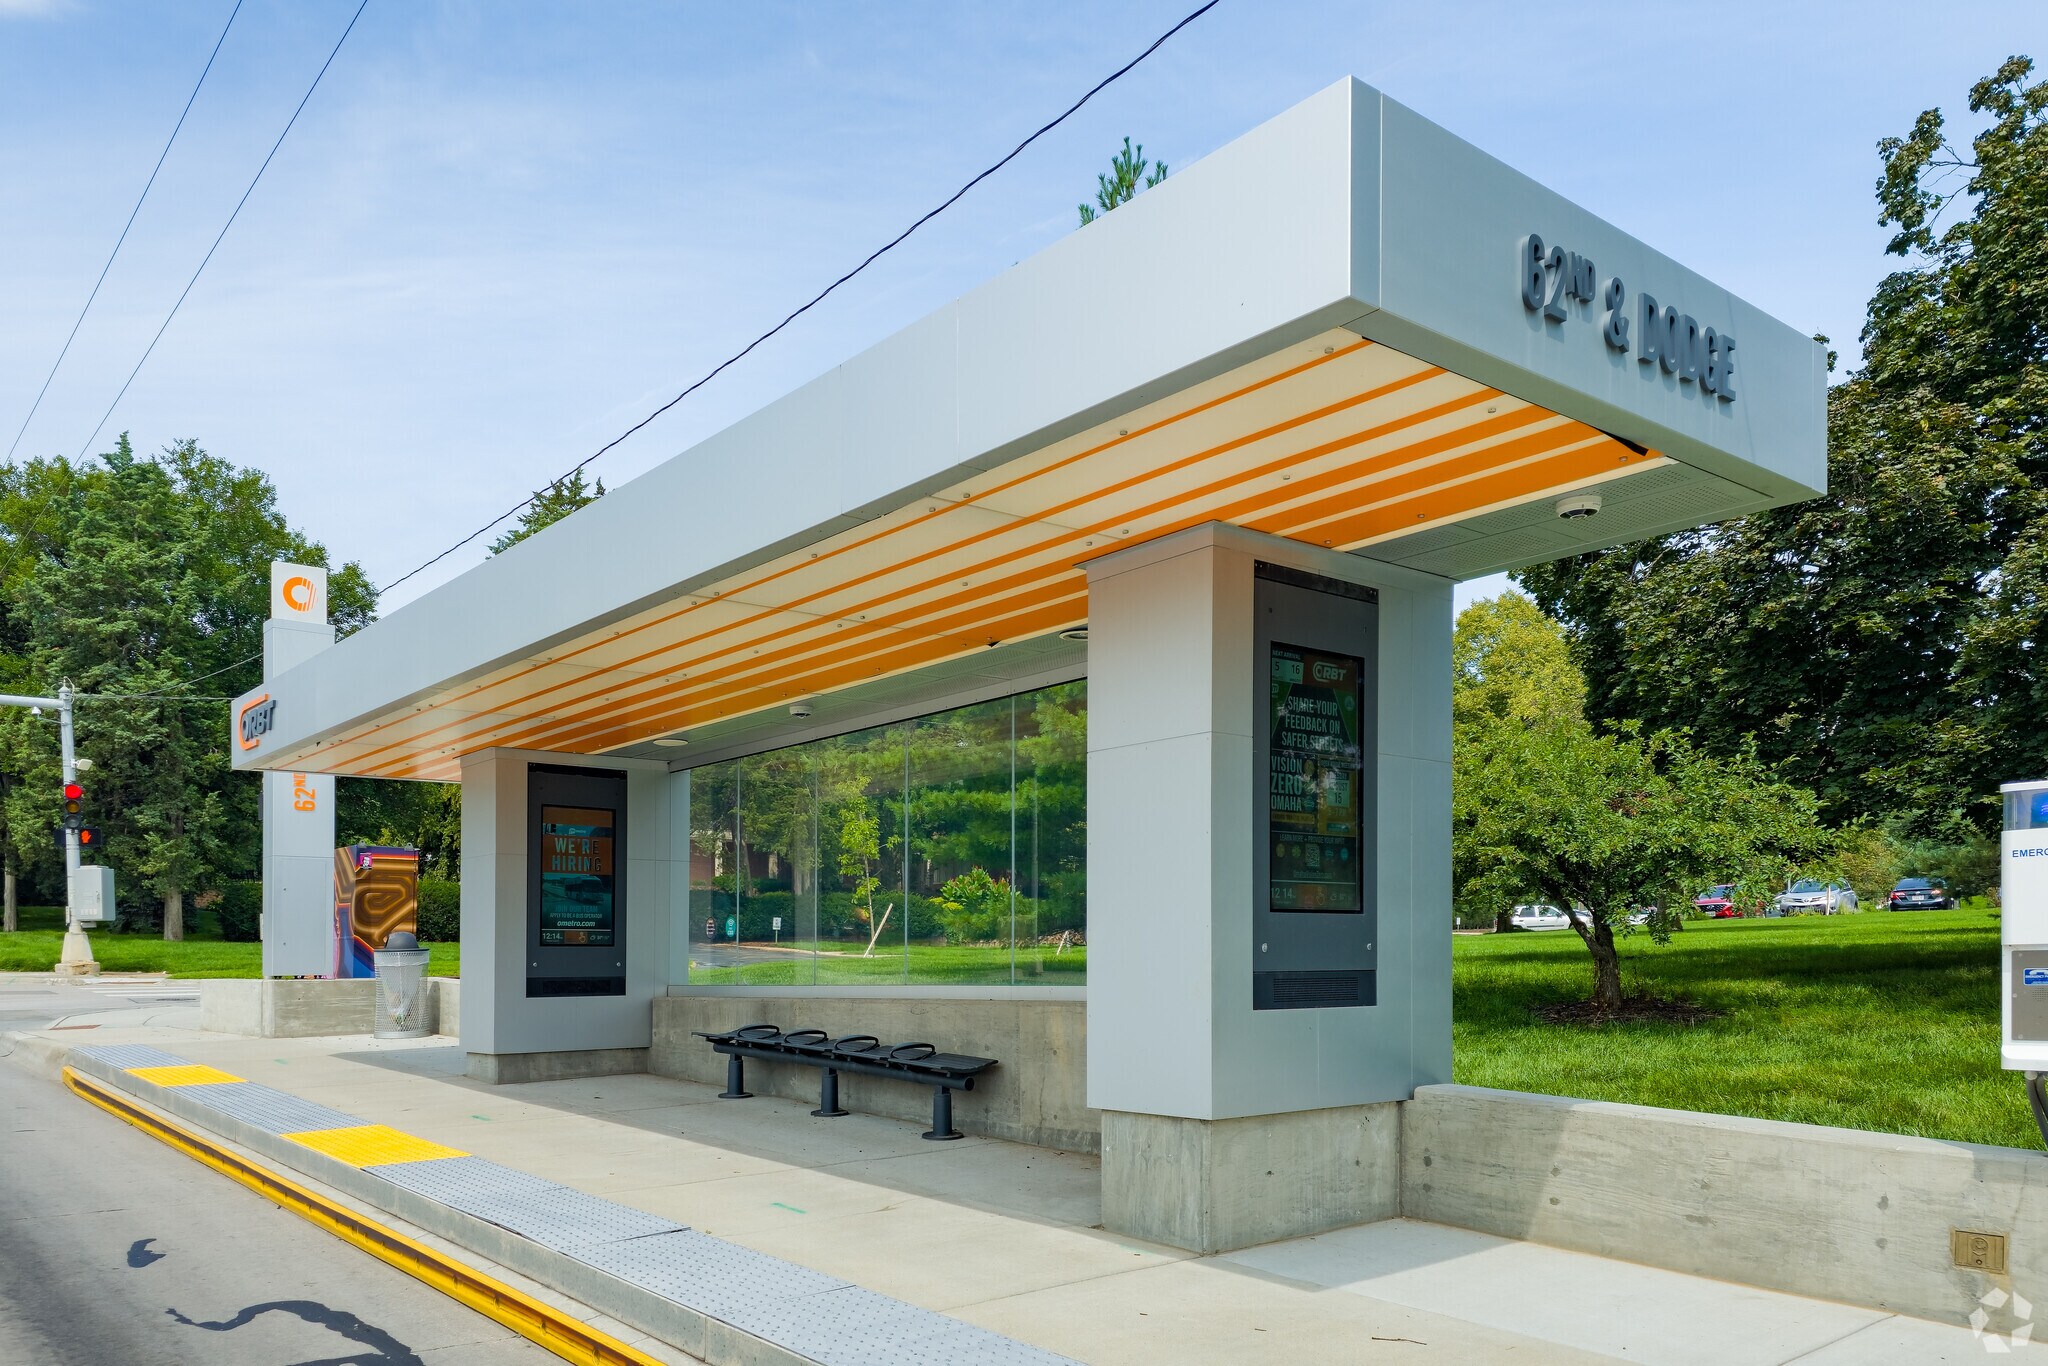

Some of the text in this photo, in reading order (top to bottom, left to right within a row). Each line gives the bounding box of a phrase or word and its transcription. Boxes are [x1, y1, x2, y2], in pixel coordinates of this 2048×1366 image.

[1522, 233, 1736, 402] 62ND & DODGE
[1291, 664, 1301, 675] 16
[1313, 662, 1348, 683] ORBT
[1287, 695, 1338, 716] SHARE YOUR
[240, 697, 278, 746] ORBT
[1285, 713, 1340, 734] FEEDBACK ON
[1281, 731, 1344, 752] SAFER STREETS
[1271, 756, 1302, 773] VISION
[1271, 773, 1302, 795] ZERO
[1271, 795, 1302, 811] OMAHA
[1334, 792, 1343, 804] 15
[555, 837, 600, 855] WE'RE
[551, 854, 601, 872] HIRING
[554, 904, 598, 914] JOIN OUR TEAM
[557, 920, 596, 928] ometro.com
